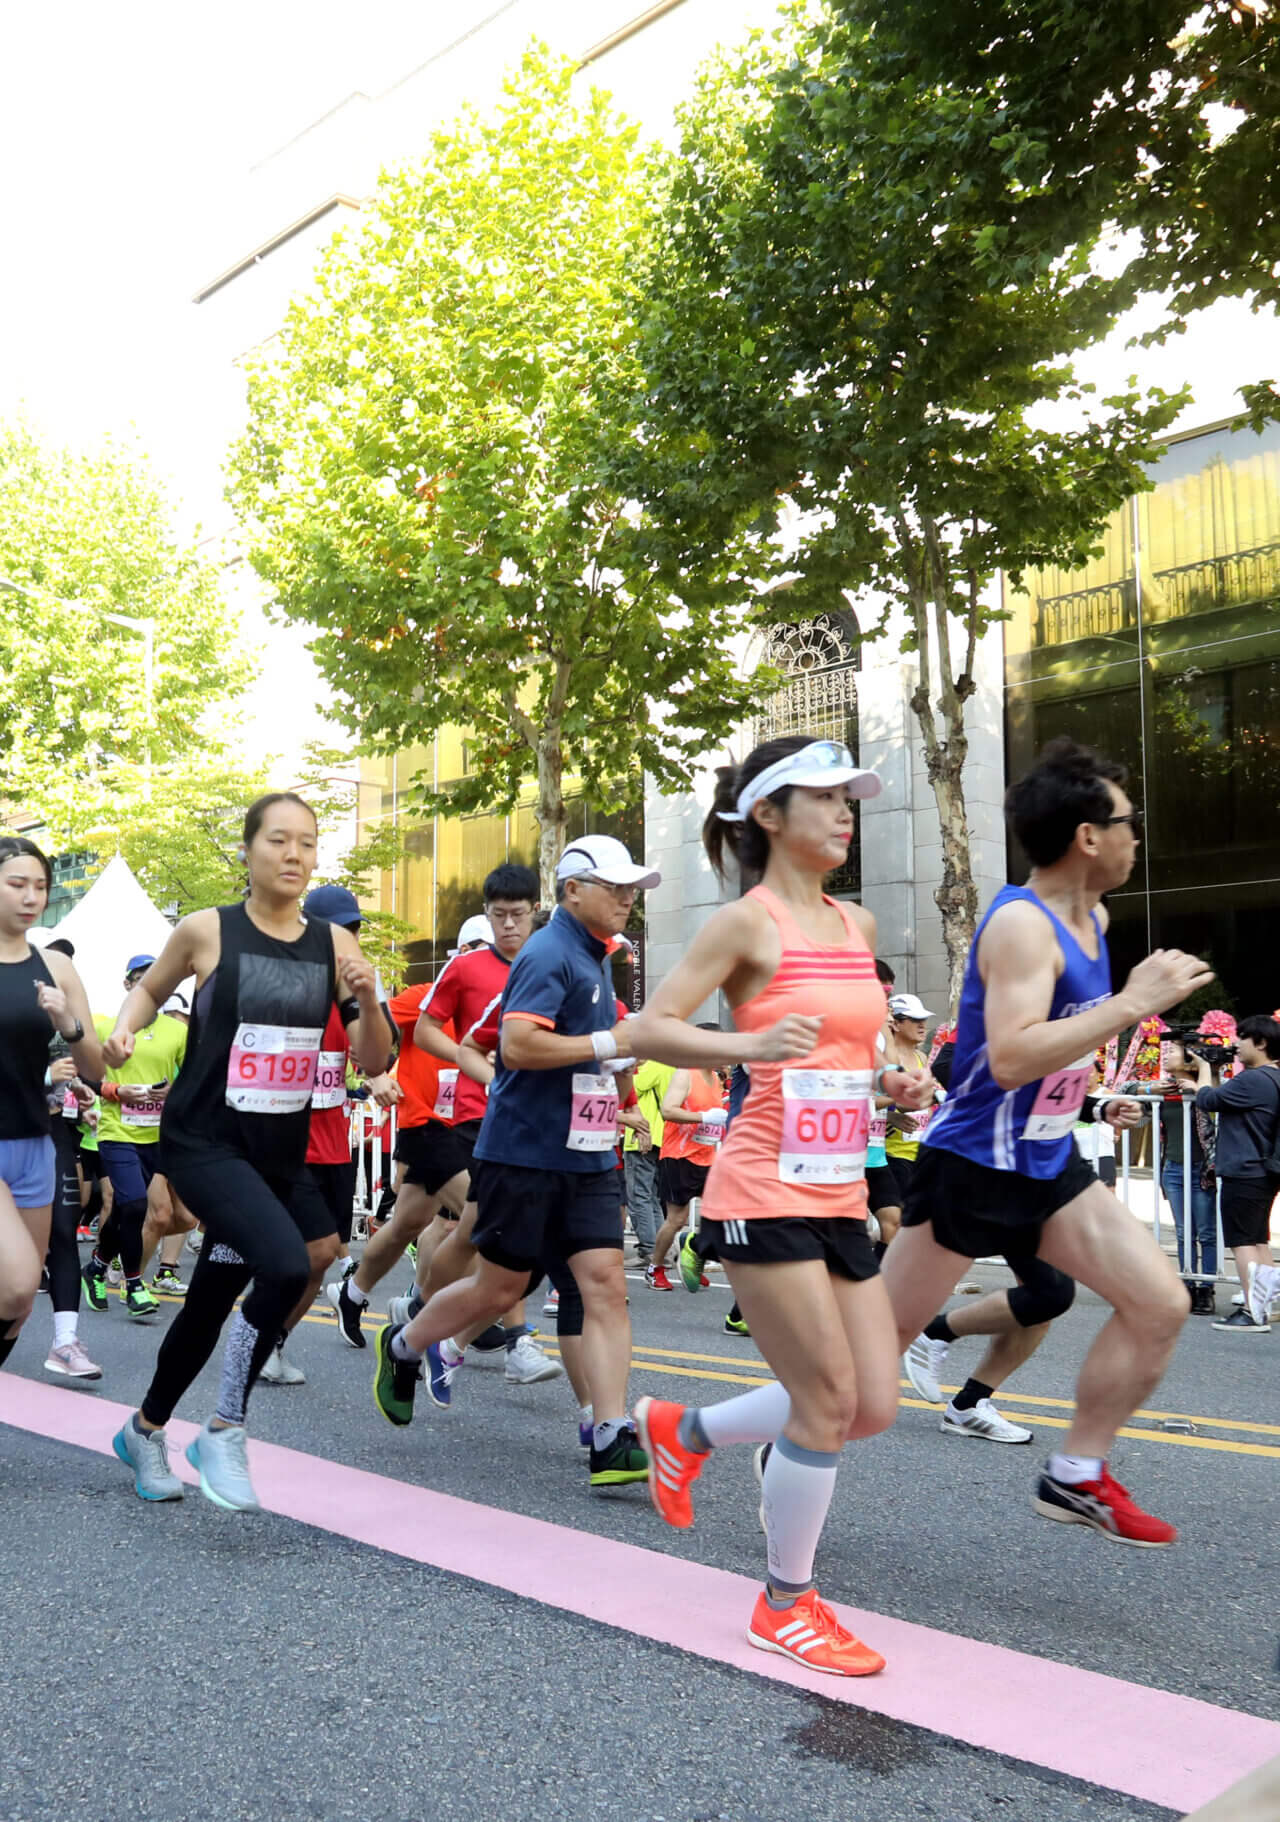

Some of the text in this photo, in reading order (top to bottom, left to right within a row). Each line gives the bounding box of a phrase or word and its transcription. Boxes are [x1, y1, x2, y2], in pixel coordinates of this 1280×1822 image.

[632, 940, 641, 975] NOBLE
[242, 1032, 256, 1048] C
[239, 1052, 311, 1083] 6193
